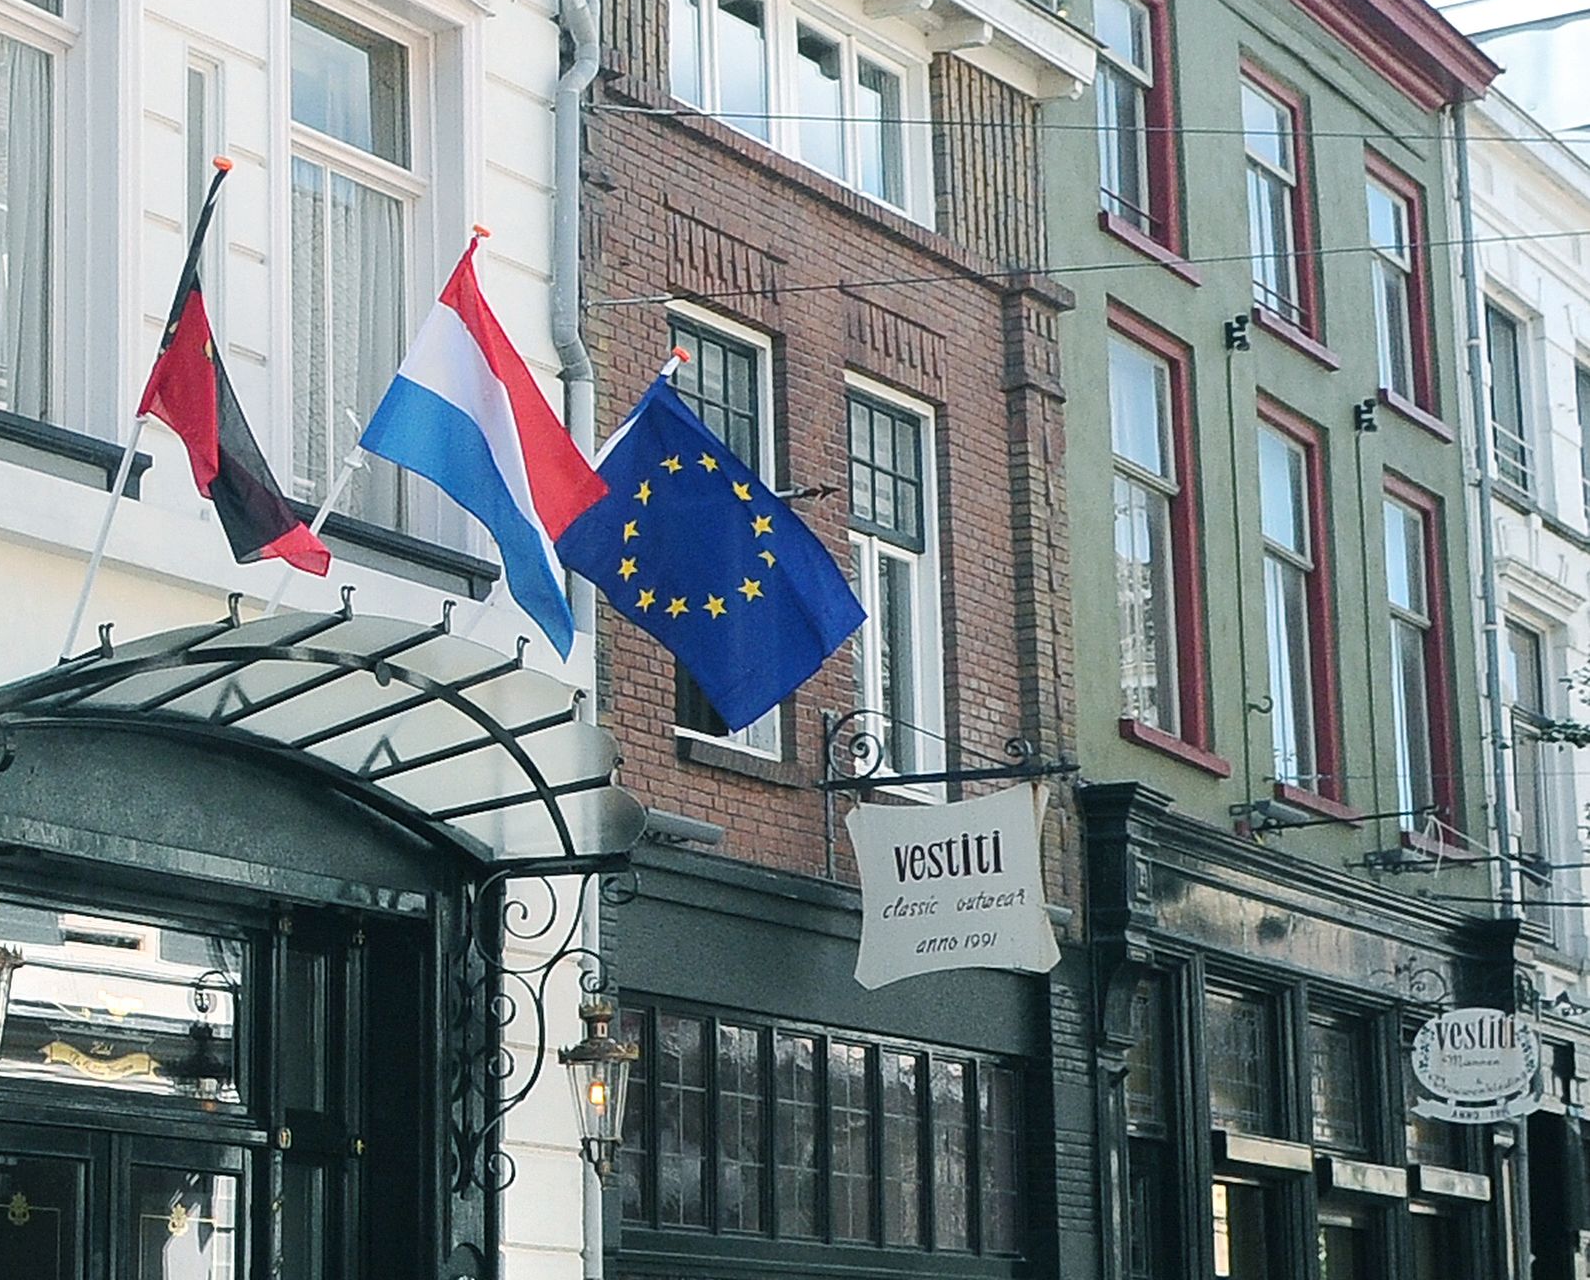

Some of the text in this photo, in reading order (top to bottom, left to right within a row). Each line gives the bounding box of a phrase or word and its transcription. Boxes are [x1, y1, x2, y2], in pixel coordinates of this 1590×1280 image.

[894, 831, 1005, 882] vestiti
[882, 888, 1026, 919] classic outwear
[916, 932, 998, 954] anno 1991
[1435, 1015, 1516, 1051] vestiti
